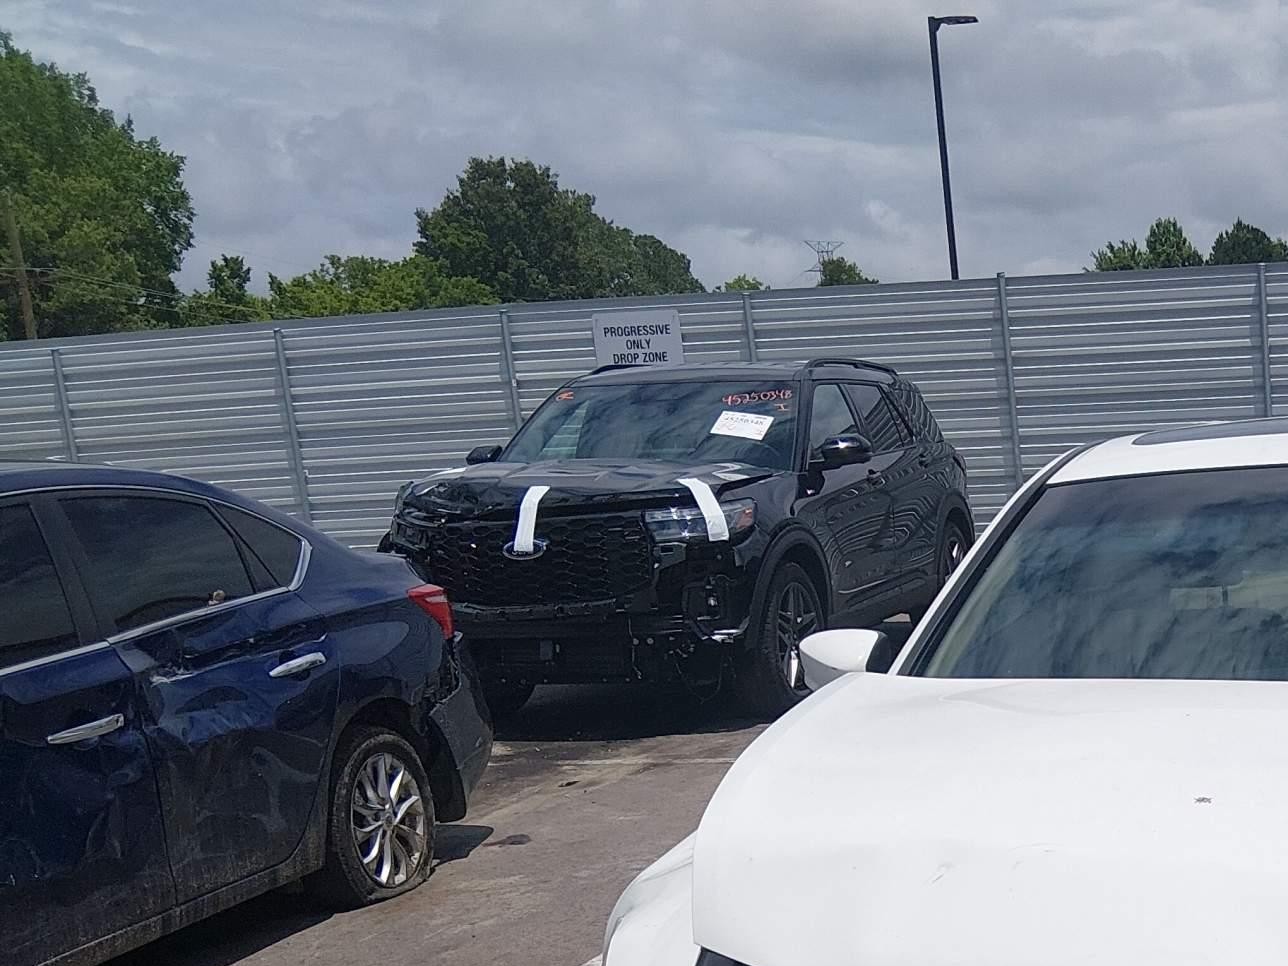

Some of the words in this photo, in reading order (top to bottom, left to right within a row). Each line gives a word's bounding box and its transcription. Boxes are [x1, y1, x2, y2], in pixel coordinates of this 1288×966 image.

[603, 323, 671, 338] PROGRESSIVE
[626, 338, 651, 350] ONLY
[612, 352, 640, 365] DROP
[643, 351, 669, 363] ZONE
